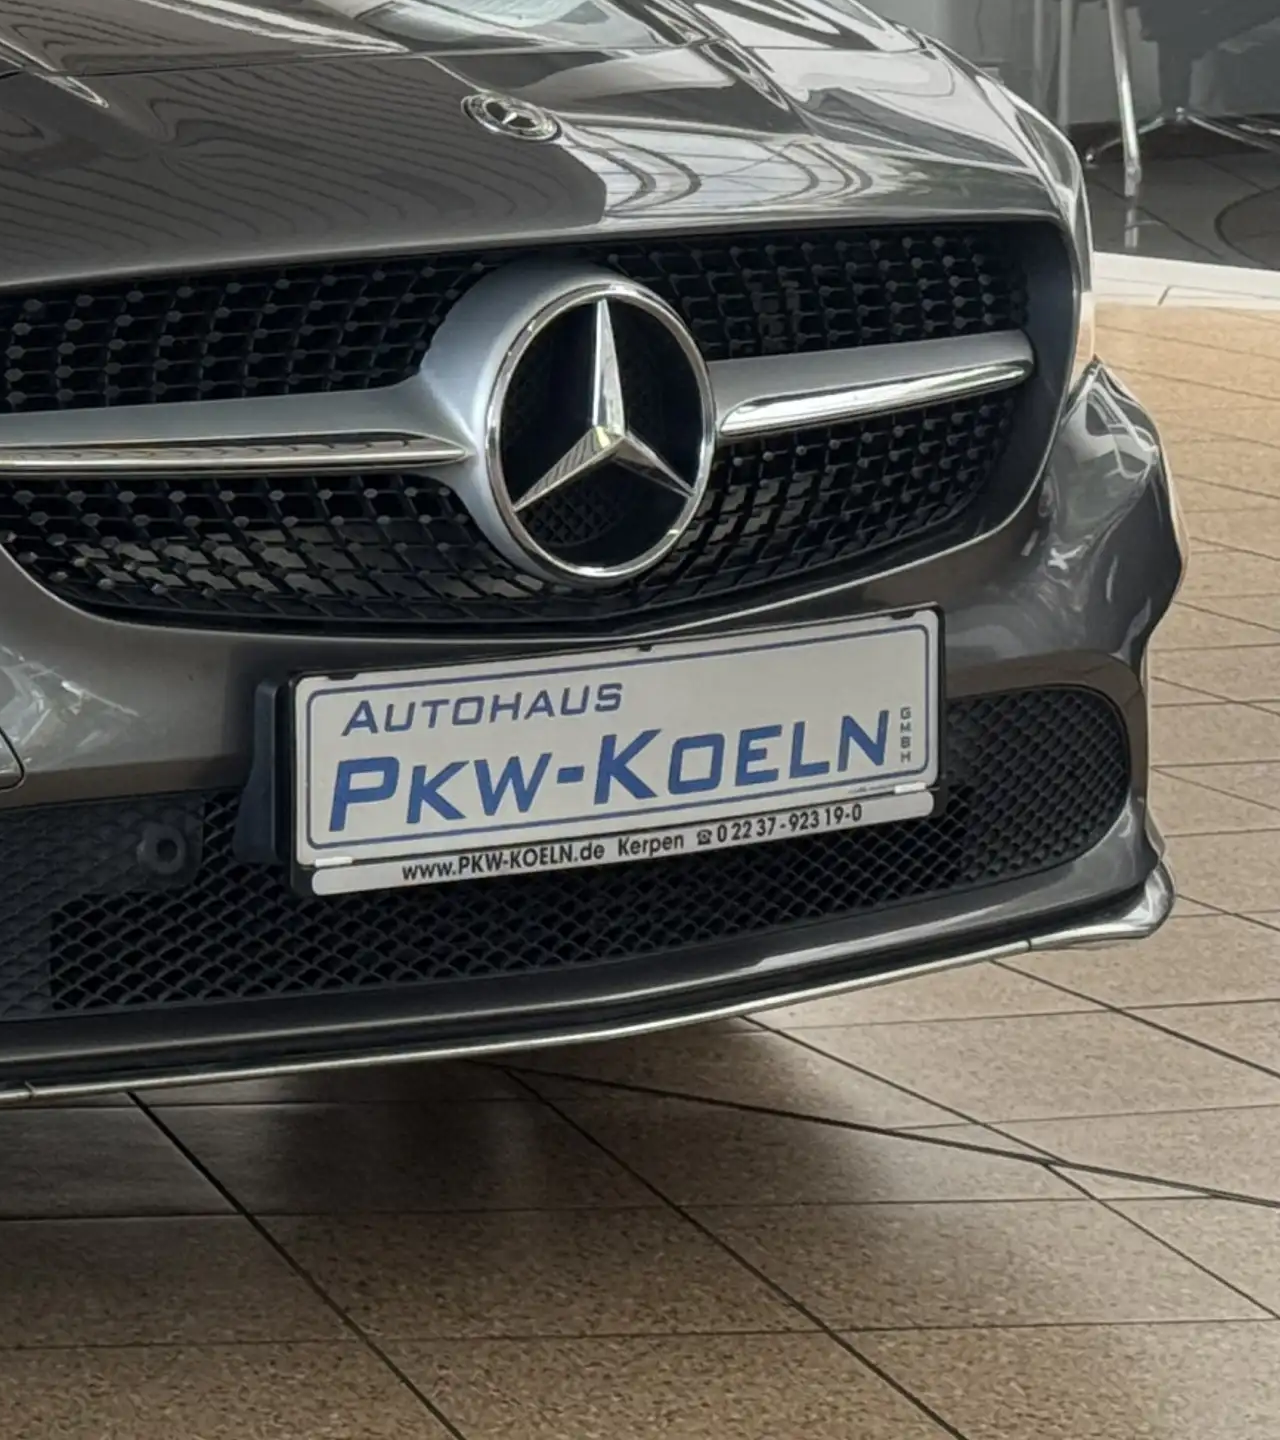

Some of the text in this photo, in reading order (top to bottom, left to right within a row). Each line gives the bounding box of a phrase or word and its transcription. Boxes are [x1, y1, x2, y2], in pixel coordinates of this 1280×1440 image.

[341, 683, 622, 736] AUTOHAUS
[329, 710, 889, 831] PKW-KOELN
[402, 842, 605, 880] www.PKW-KOELN.de
[618, 833, 684, 857] Kerpen
